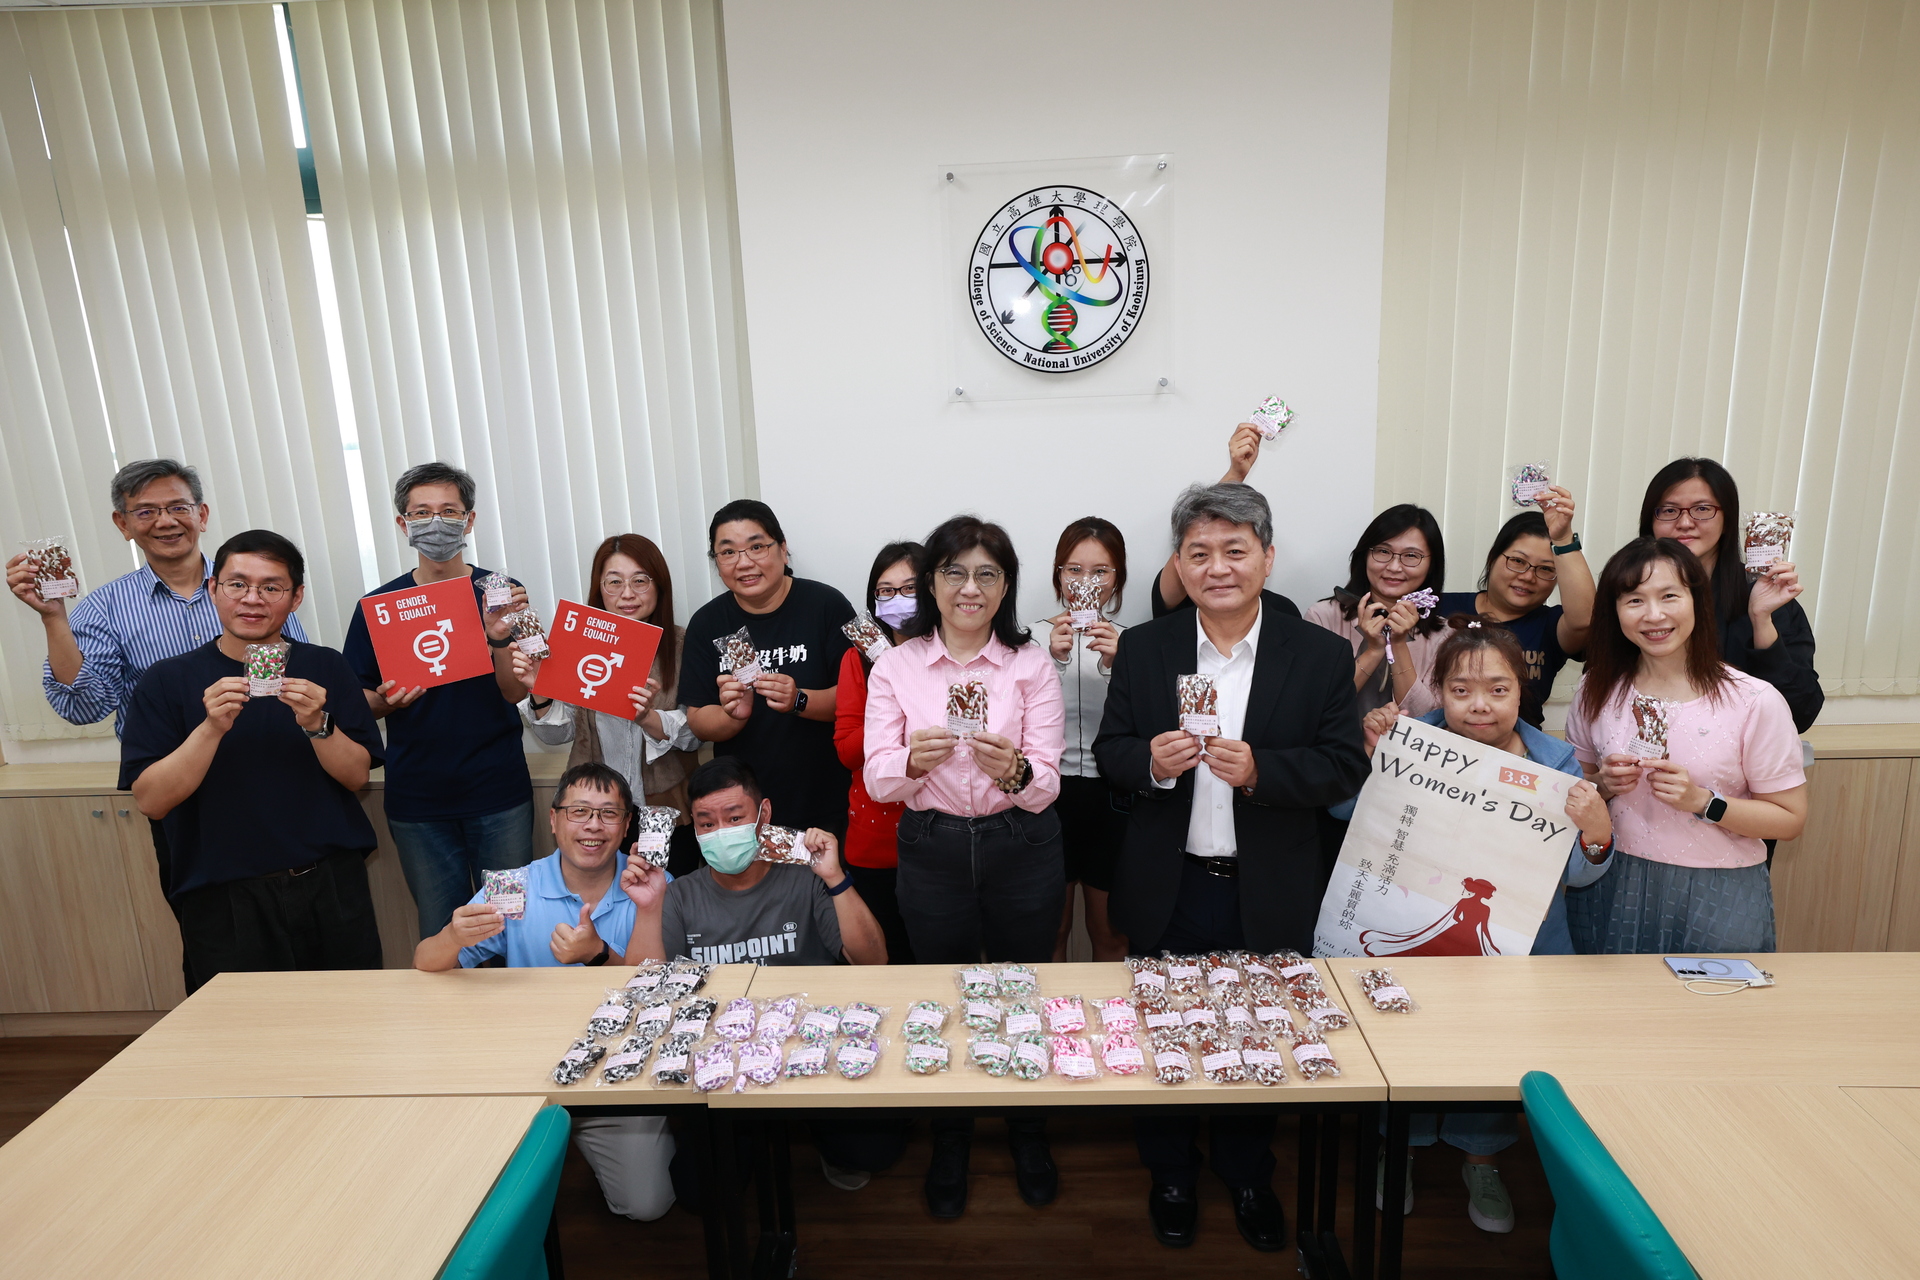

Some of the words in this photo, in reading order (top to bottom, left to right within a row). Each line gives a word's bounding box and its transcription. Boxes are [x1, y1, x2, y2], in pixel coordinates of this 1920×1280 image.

[979, 190, 1137, 256] 國立高雄大學理學院
[972, 266, 984, 306] College
[1126, 259, 1146, 319] Kaohsiung
[980, 310, 992, 321] of
[1121, 319, 1132, 332] of
[986, 321, 1018, 355] Science
[1073, 333, 1123, 366] University
[1023, 352, 1070, 369] National
[395, 594, 428, 610] GENDER
[399, 604, 437, 621] EQUALITY
[374, 603, 391, 625] 5
[563, 610, 579, 632] 5
[586, 616, 617, 633] GENDER
[582, 627, 620, 646] EQUALITY
[1522, 650, 1545, 666] UK
[1388, 721, 1479, 775] Happy
[1504, 770, 1530, 787] 3.8
[1380, 752, 1498, 812] Women's
[1509, 800, 1567, 842] Day
[1399, 804, 1419, 828] 獨特
[1391, 828, 1409, 852] 智慧
[1374, 853, 1400, 896] 充滿活力
[1338, 858, 1373, 931] 致天生麗質的妳
[691, 932, 797, 965] SUNPOINT
[1316, 935, 1335, 949] You
[1339, 947, 1359, 958] Are
